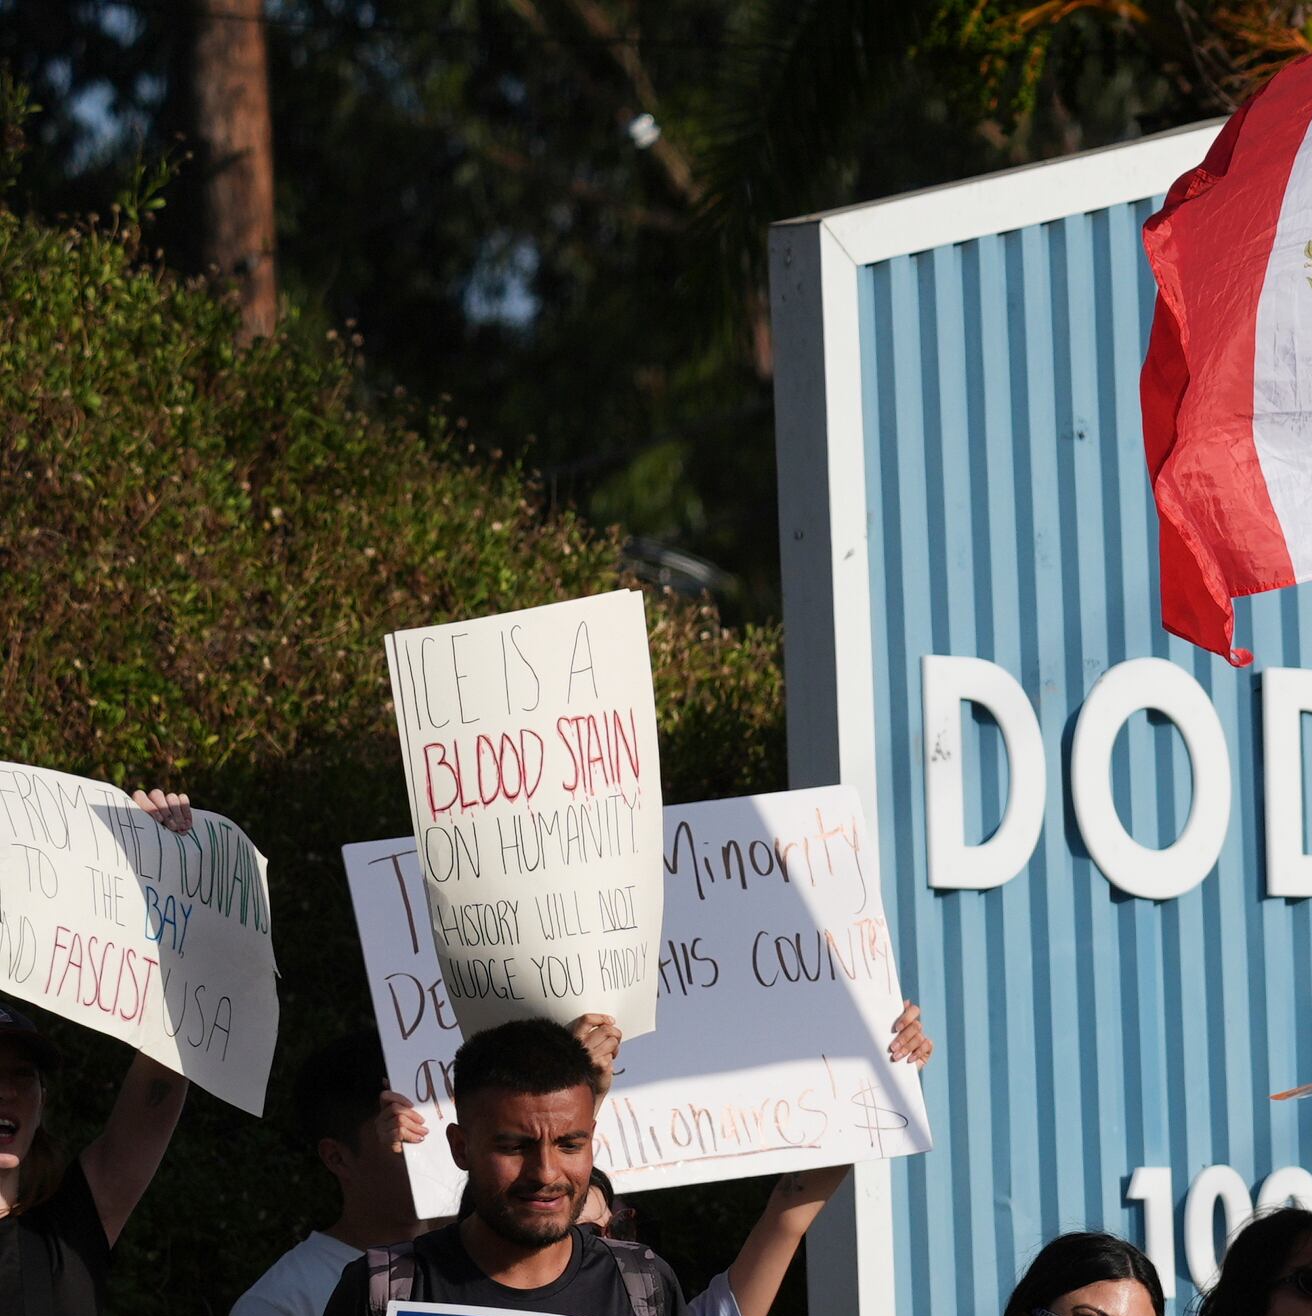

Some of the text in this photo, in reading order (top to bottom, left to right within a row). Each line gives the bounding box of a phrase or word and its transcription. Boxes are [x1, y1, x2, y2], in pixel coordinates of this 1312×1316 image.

[405, 621, 598, 729] ICE IS A
[423, 707, 641, 817] BLOOD STAIN
[0, 770, 100, 862] FROM
[96, 788, 154, 880] THE
[425, 822, 480, 882] ON
[11, 843, 193, 959] TO THE BAY,
[437, 900, 519, 947] HISTORY
[535, 889, 591, 941] WILL
[598, 885, 638, 932] NOT
[0, 911, 232, 1062] ND FASCIST USA
[448, 941, 648, 1001] JUDGE YOU KINDLY
[657, 918, 892, 998] HIS COUNTRY
